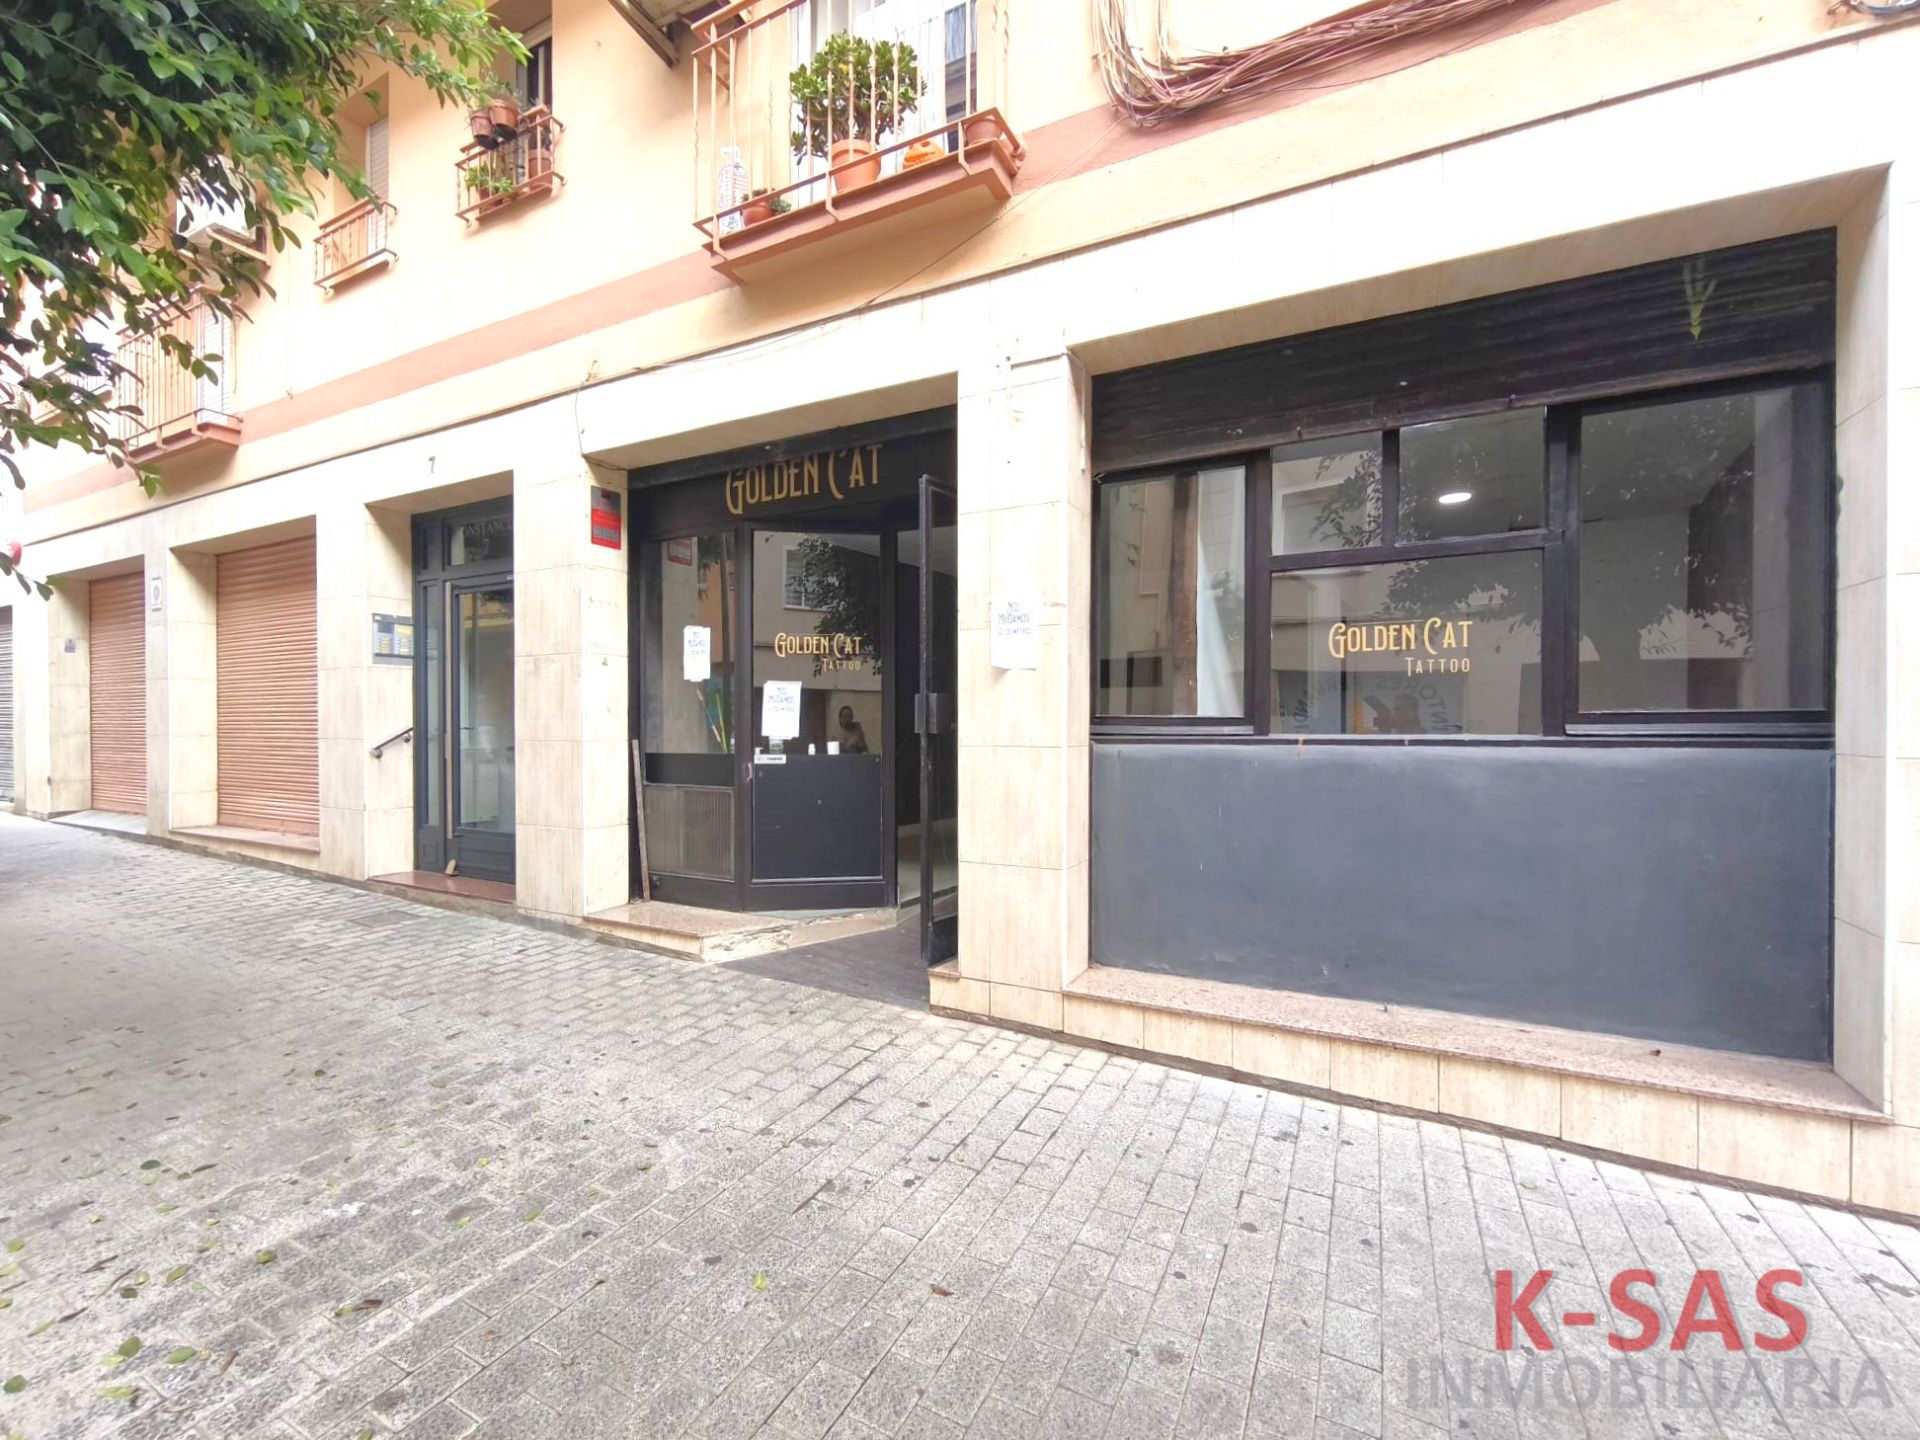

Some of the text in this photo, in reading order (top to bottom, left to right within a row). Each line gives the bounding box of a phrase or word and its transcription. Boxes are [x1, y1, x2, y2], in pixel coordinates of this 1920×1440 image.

[725, 443, 885, 515] GOLDEN CAT
[774, 632, 863, 658] GOLDEN CAT
[1328, 617, 1473, 659] GOLDEN CAT
[821, 658, 862, 673] TATTOO
[1404, 657, 1471, 677] TATTOO
